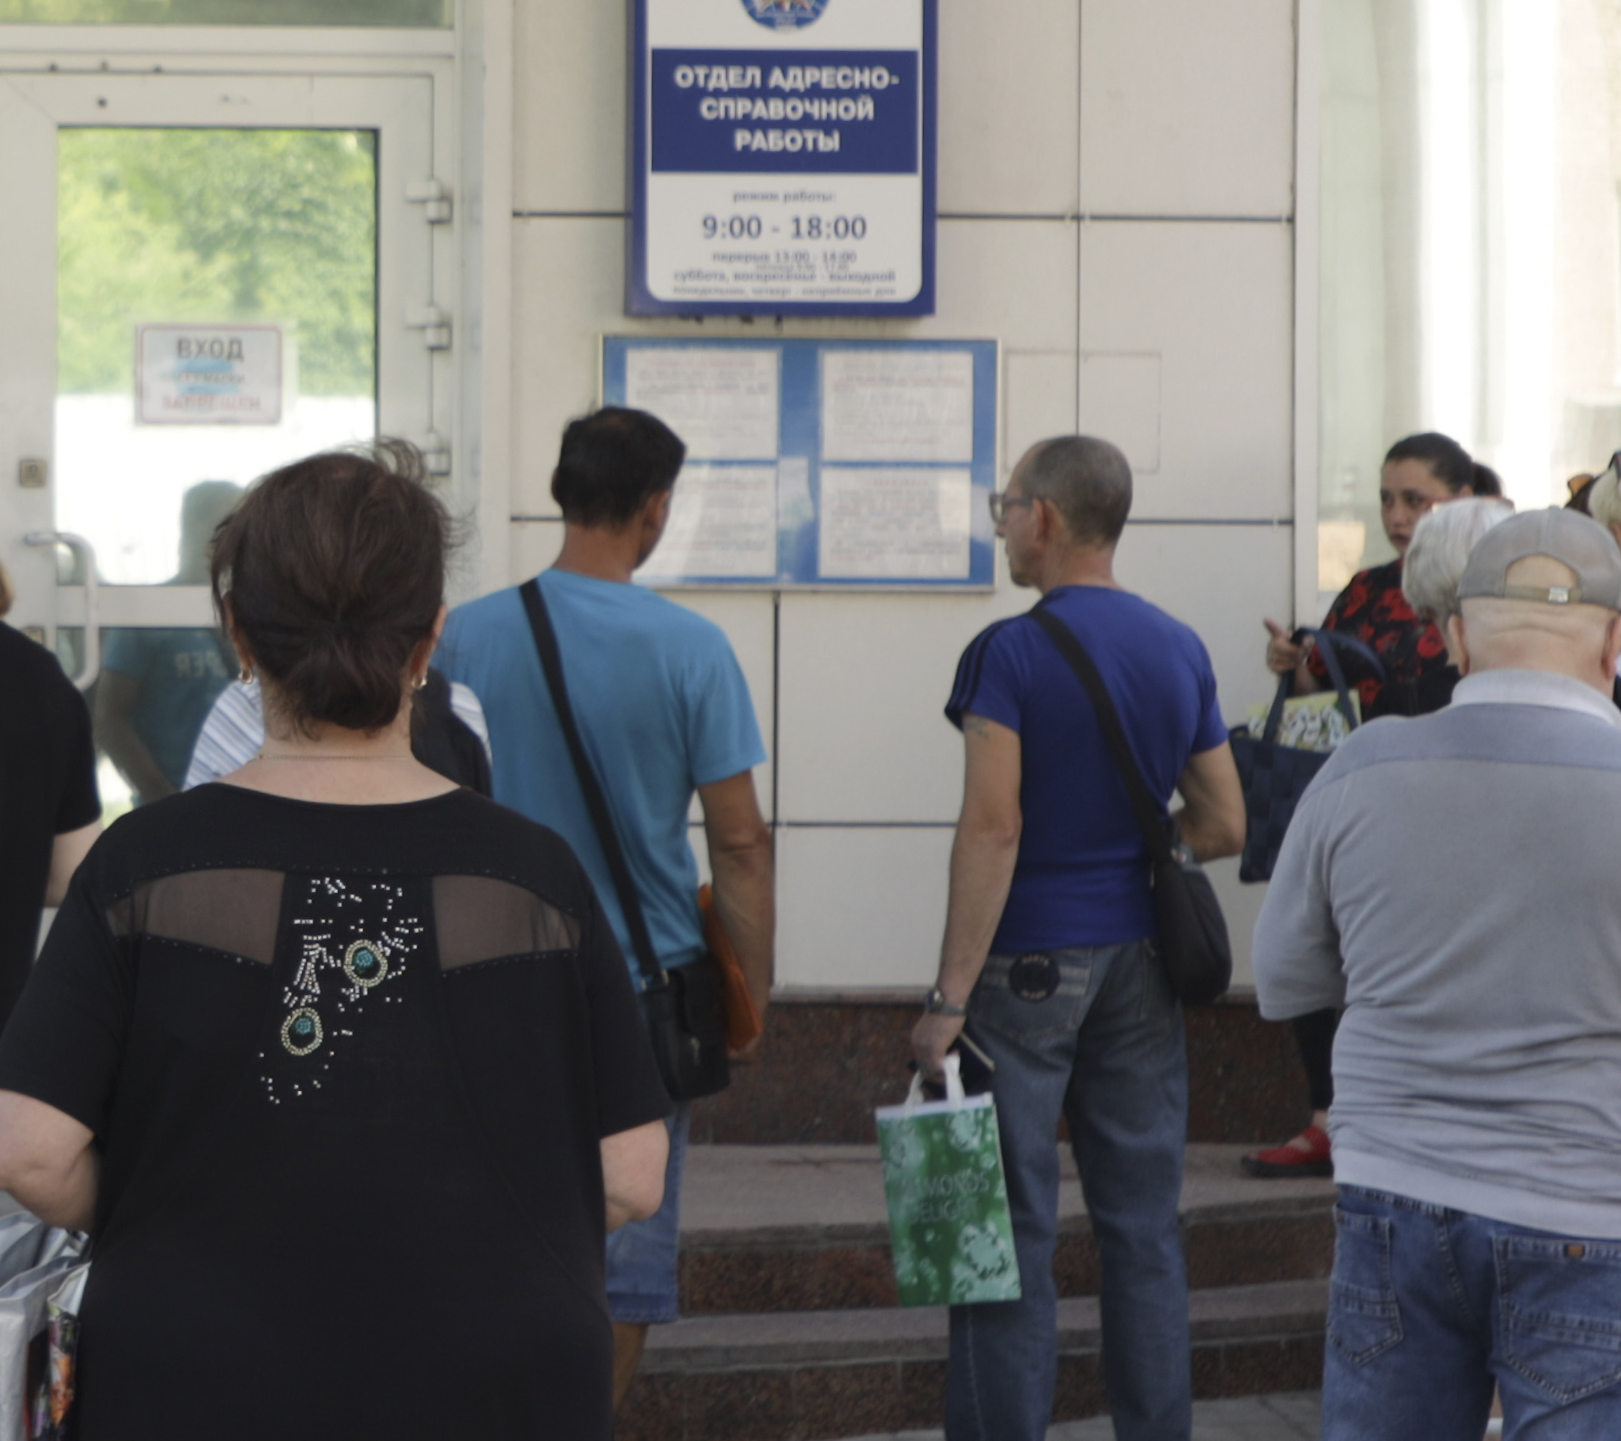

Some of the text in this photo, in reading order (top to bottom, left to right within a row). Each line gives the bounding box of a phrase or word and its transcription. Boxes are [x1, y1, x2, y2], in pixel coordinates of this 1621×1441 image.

[674, 65, 900, 92] ОТДЕЛ АДРЕСНО-
[700, 95, 875, 121] СПРАВОЧНОЙ
[734, 130, 840, 152] РАБОТЫ
[702, 214, 762, 239] 9:00
[791, 215, 867, 240] 18:00
[176, 337, 246, 363] ВХОД
